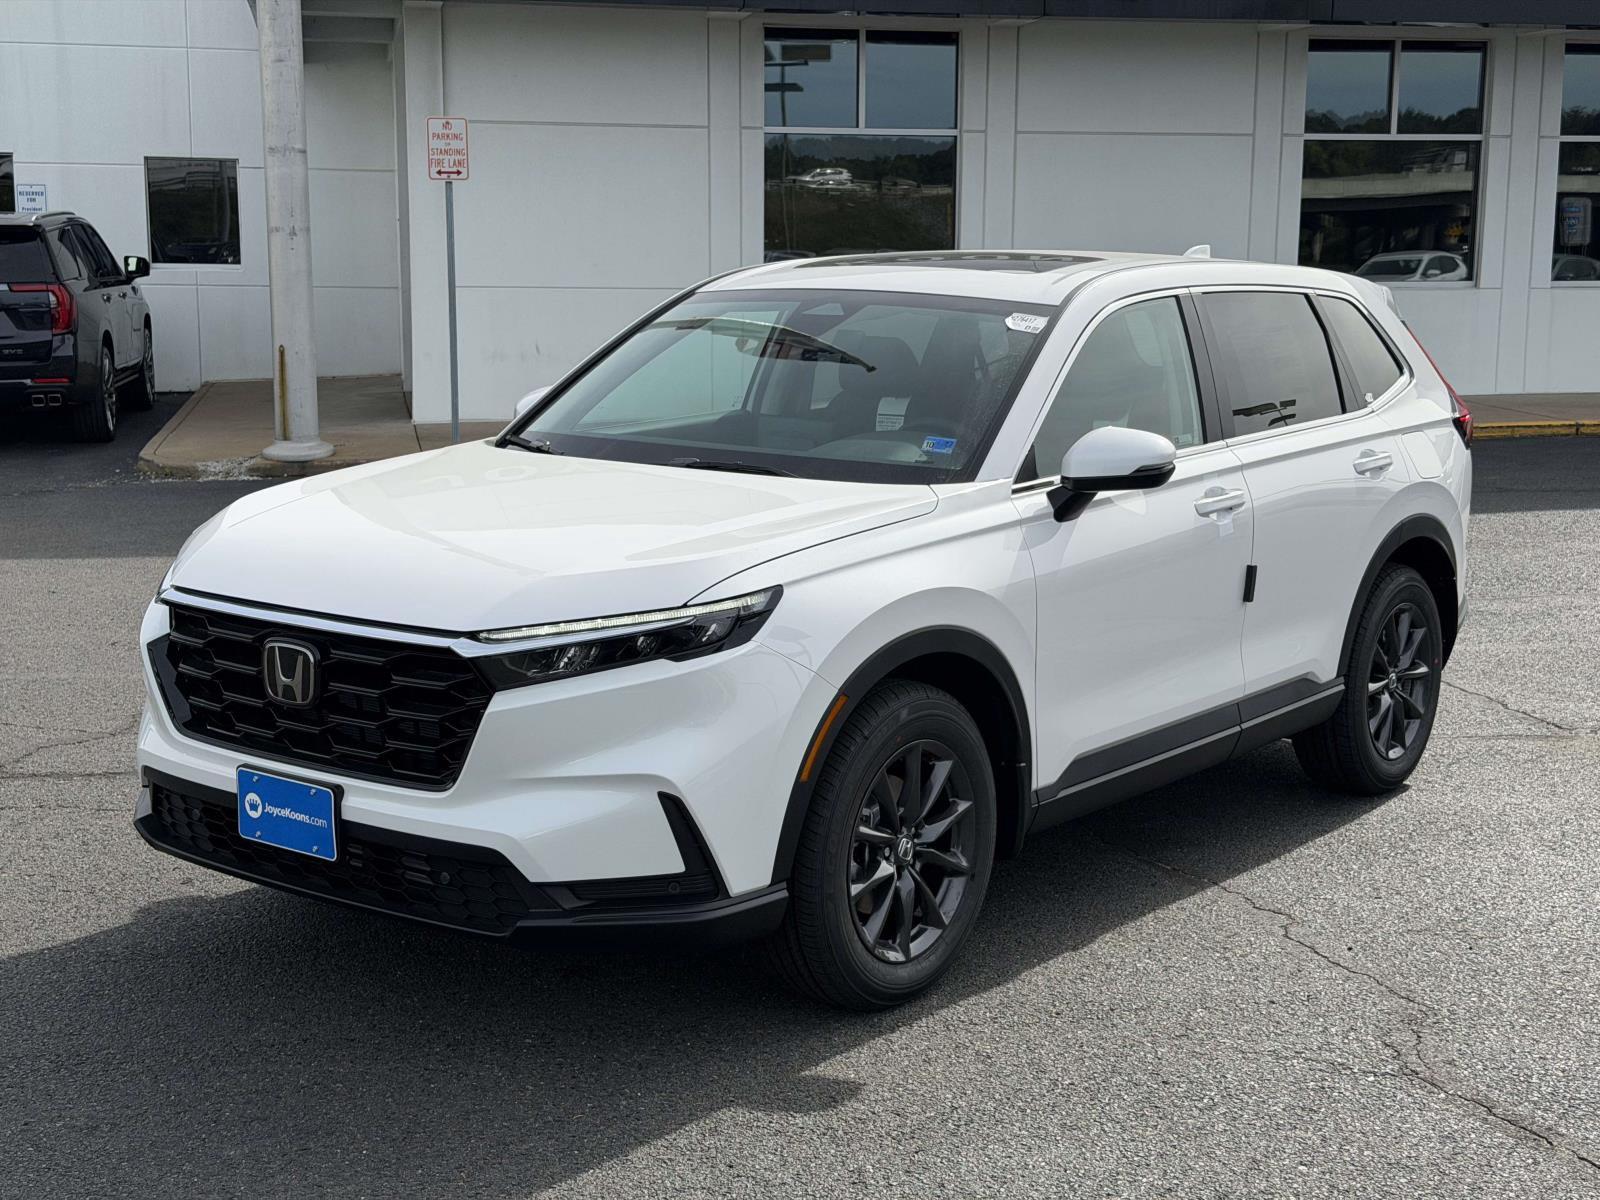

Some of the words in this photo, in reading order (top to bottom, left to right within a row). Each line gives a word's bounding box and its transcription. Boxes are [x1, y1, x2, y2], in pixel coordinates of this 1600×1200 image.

[442, 121, 452, 131] NO
[432, 132, 463, 142] PARKING
[431, 148, 465, 157] STANDING
[431, 159, 446, 168] FIRE
[448, 159, 466, 169] LANE
[264, 802, 328, 829] JoyceKoons.com
